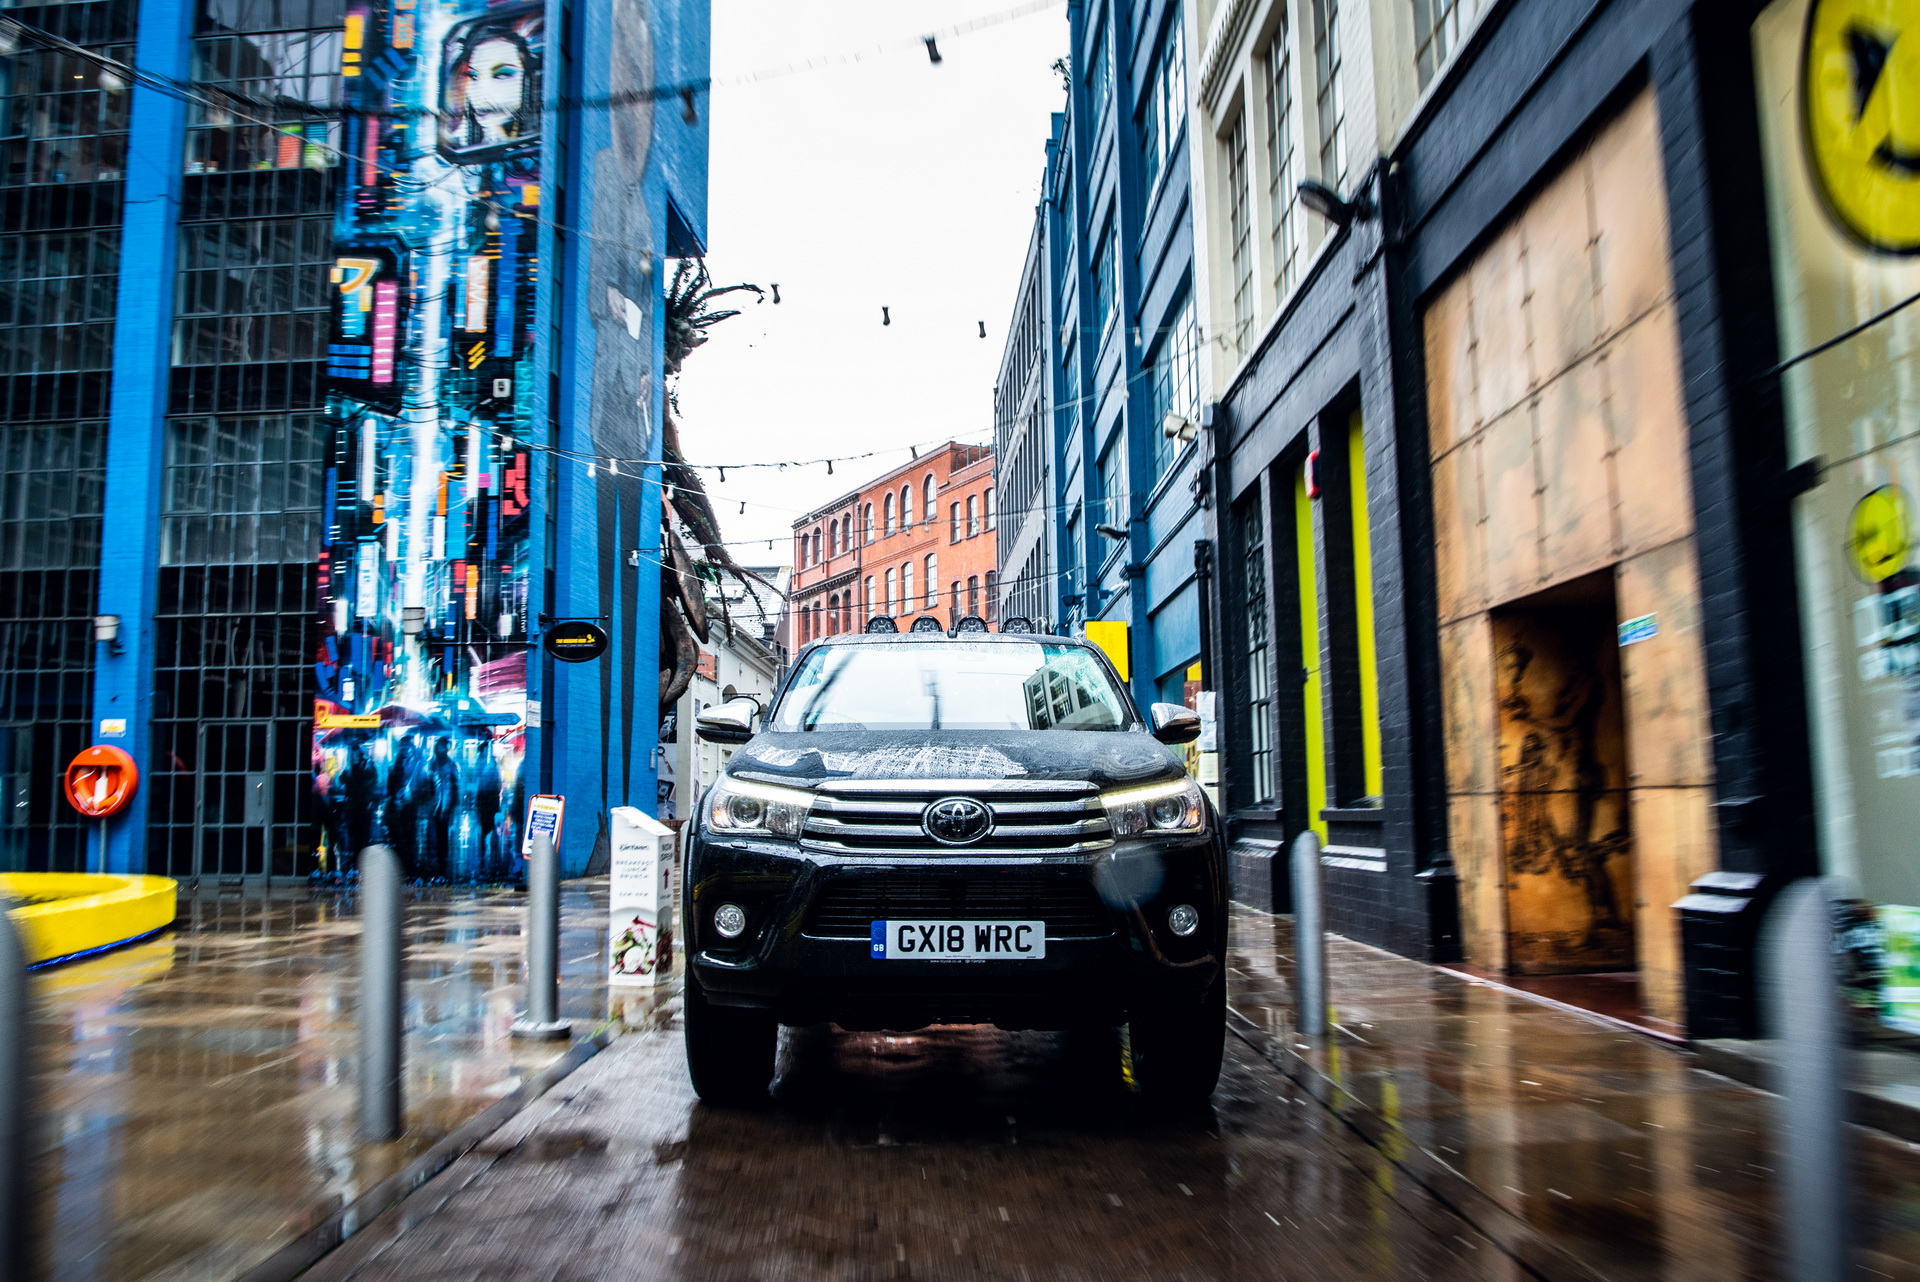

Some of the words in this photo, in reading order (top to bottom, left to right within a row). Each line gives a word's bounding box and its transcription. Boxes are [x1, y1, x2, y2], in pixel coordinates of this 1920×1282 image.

[873, 944, 884, 952] GB
[898, 925, 964, 953] GX18
[975, 925, 1033, 953] WRC
